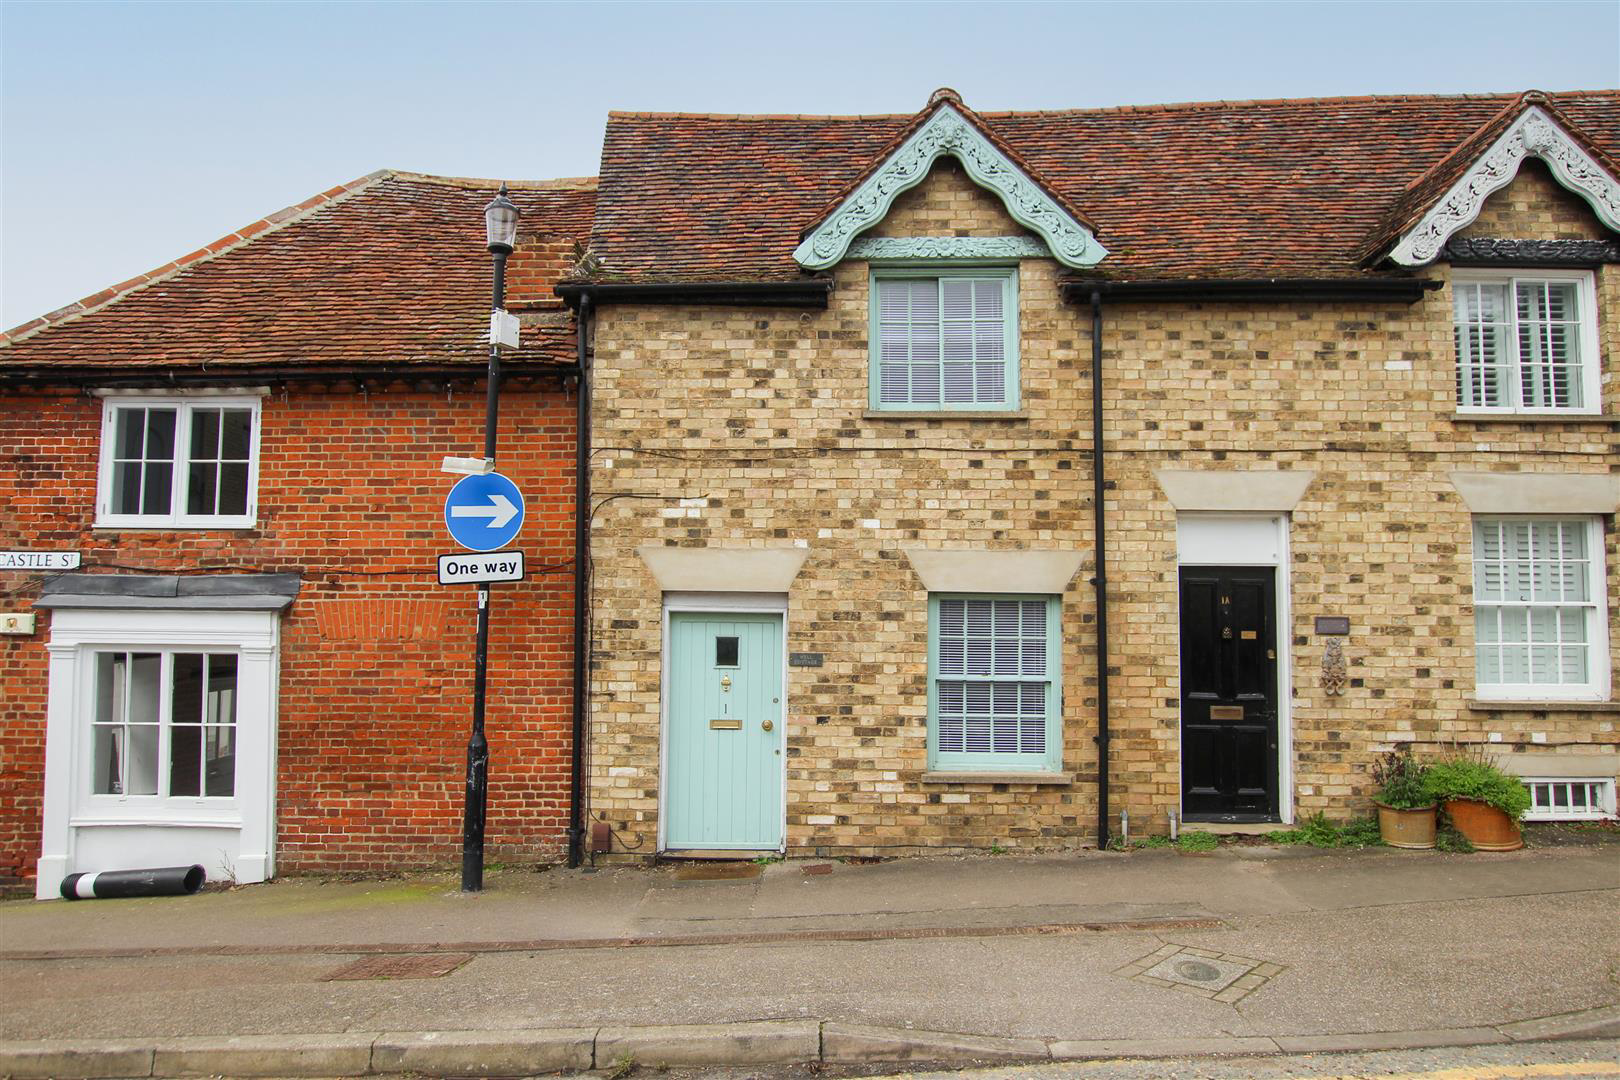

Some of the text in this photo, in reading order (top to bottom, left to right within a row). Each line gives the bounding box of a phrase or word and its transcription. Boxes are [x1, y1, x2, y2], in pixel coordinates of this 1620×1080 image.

[0, 554, 53, 567] CASTLE
[447, 562, 517, 575] One way
